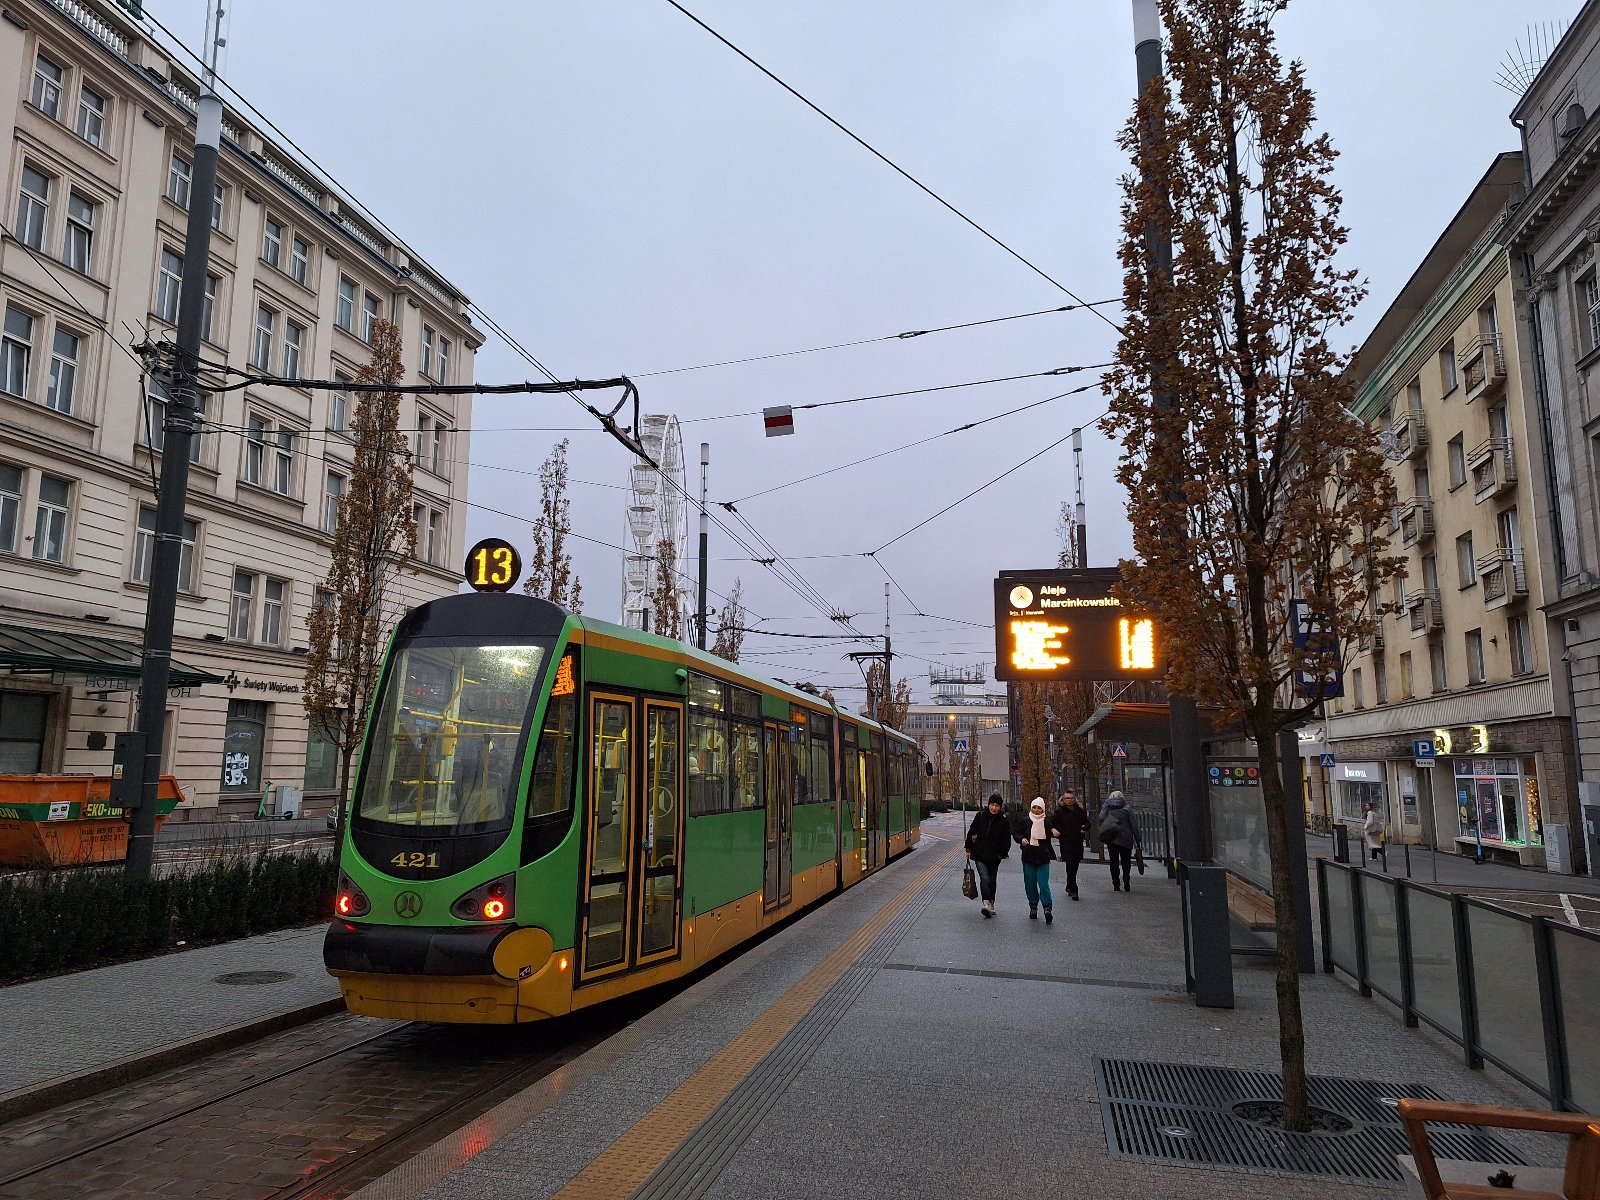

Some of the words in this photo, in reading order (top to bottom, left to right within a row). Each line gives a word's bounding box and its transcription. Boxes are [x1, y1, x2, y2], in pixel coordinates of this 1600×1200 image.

[474, 547, 512, 585] 13
[1040, 585, 1067, 596] Aleje
[1040, 597, 1122, 608] Marcinkowskie
[84, 675, 132, 690] HOTEL
[243, 677, 268, 693] Święty
[269, 681, 299, 694] Wojciech
[390, 852, 439, 868] 421
